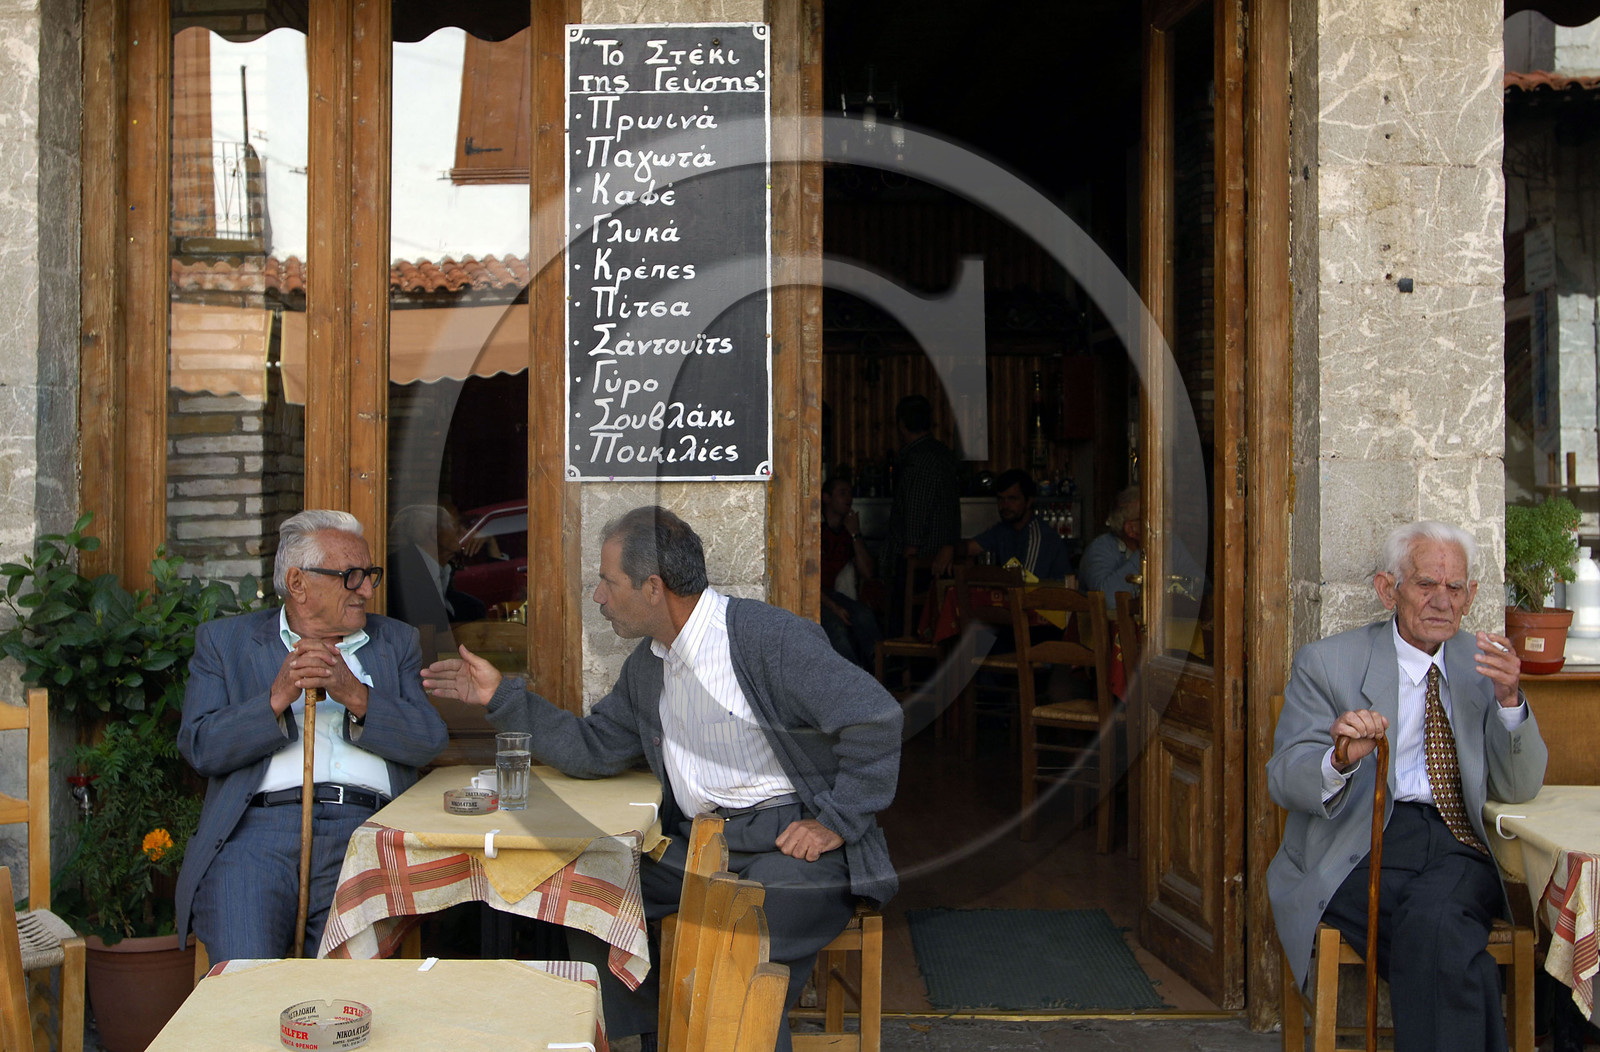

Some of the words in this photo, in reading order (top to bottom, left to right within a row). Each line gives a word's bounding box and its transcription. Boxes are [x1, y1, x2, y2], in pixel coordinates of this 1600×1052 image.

[644, 39, 741, 65] Στέκι
[578, 74, 630, 93] της
[587, 95, 718, 143] Πρωινά
[586, 135, 717, 183] Παγωτά
[591, 172, 676, 206] Καφέ
[592, 213, 681, 244] Γλυκά
[594, 247, 696, 295] Κρέπες
[591, 286, 691, 318] Πίτσα
[592, 359, 659, 408] Γύρο
[588, 397, 736, 431] Σουβλάκι
[589, 432, 739, 463] Ποικιλίες
